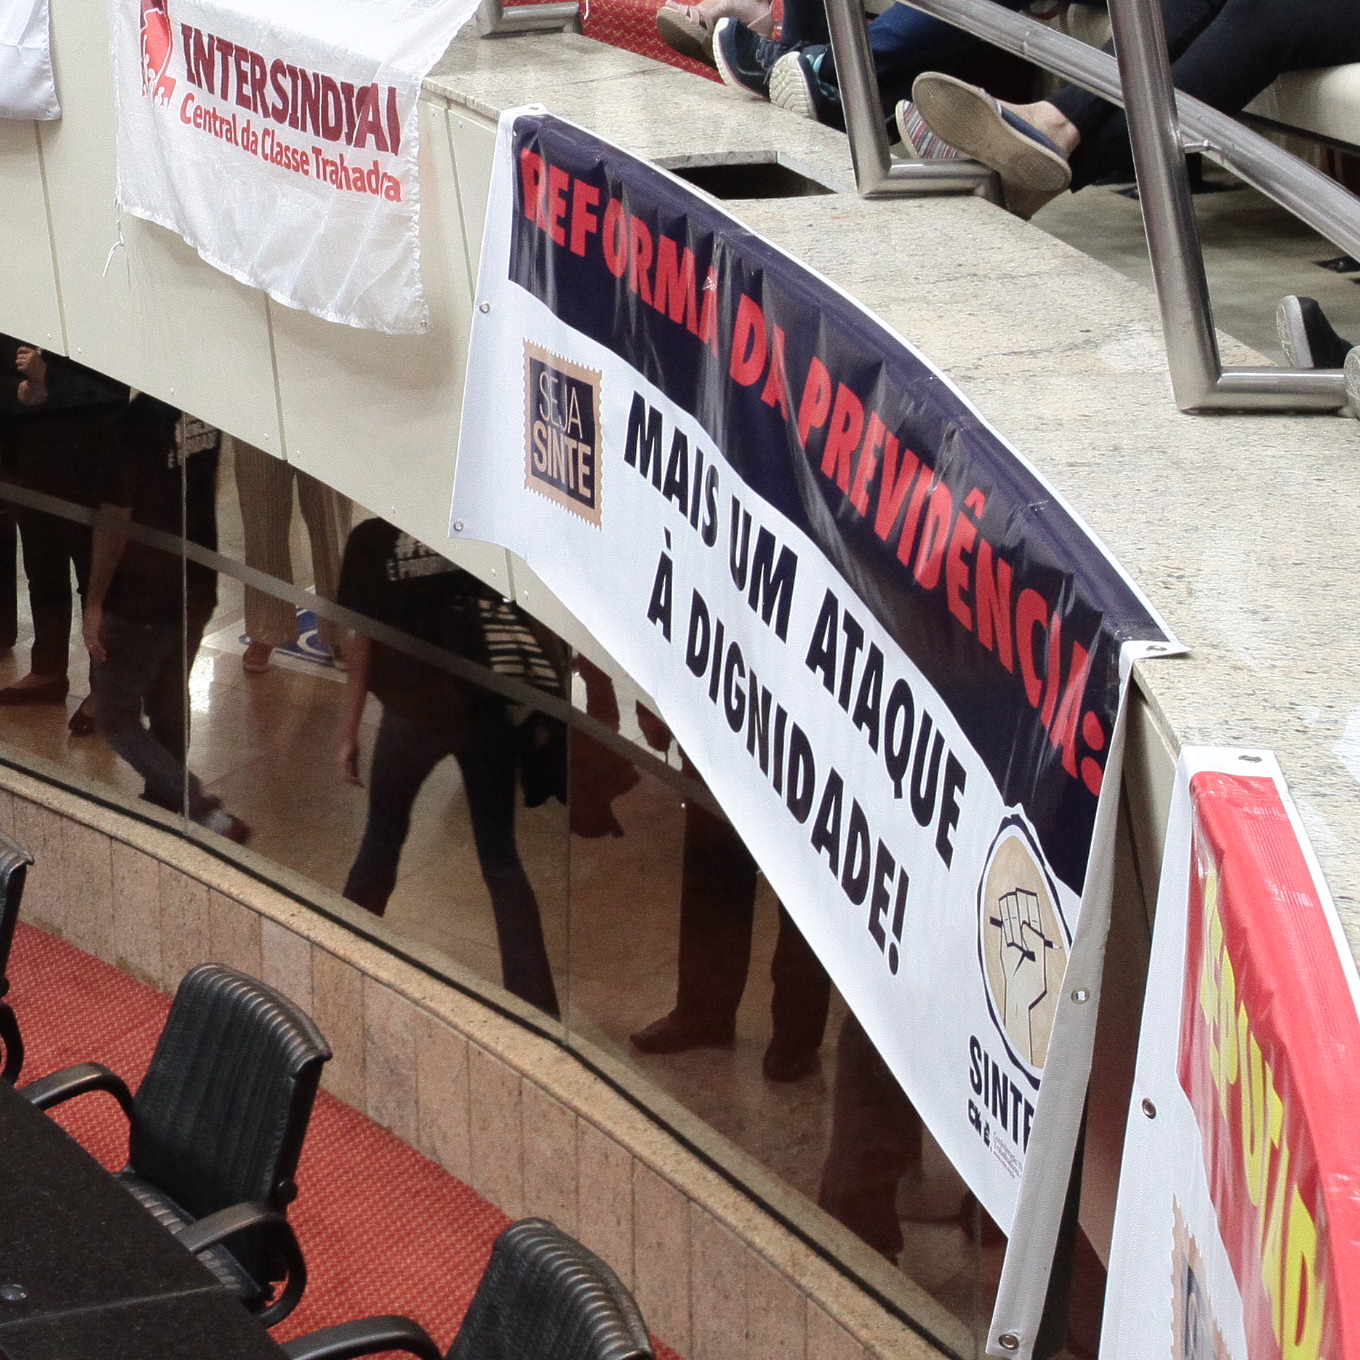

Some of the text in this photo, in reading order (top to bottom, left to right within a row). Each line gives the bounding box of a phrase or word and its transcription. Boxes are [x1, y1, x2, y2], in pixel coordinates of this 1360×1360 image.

[179, 92, 239, 147] Central
[241, 119, 259, 156] da
[260, 127, 310, 177] Classe
[521, 147, 717, 357] REFORMA
[531, 422, 593, 500] SINTE
[538, 370, 583, 440] SEJA
[623, 390, 967, 872] MAIS UM ATAQUE
[647, 526, 911, 977] À DIGNIDADE!
